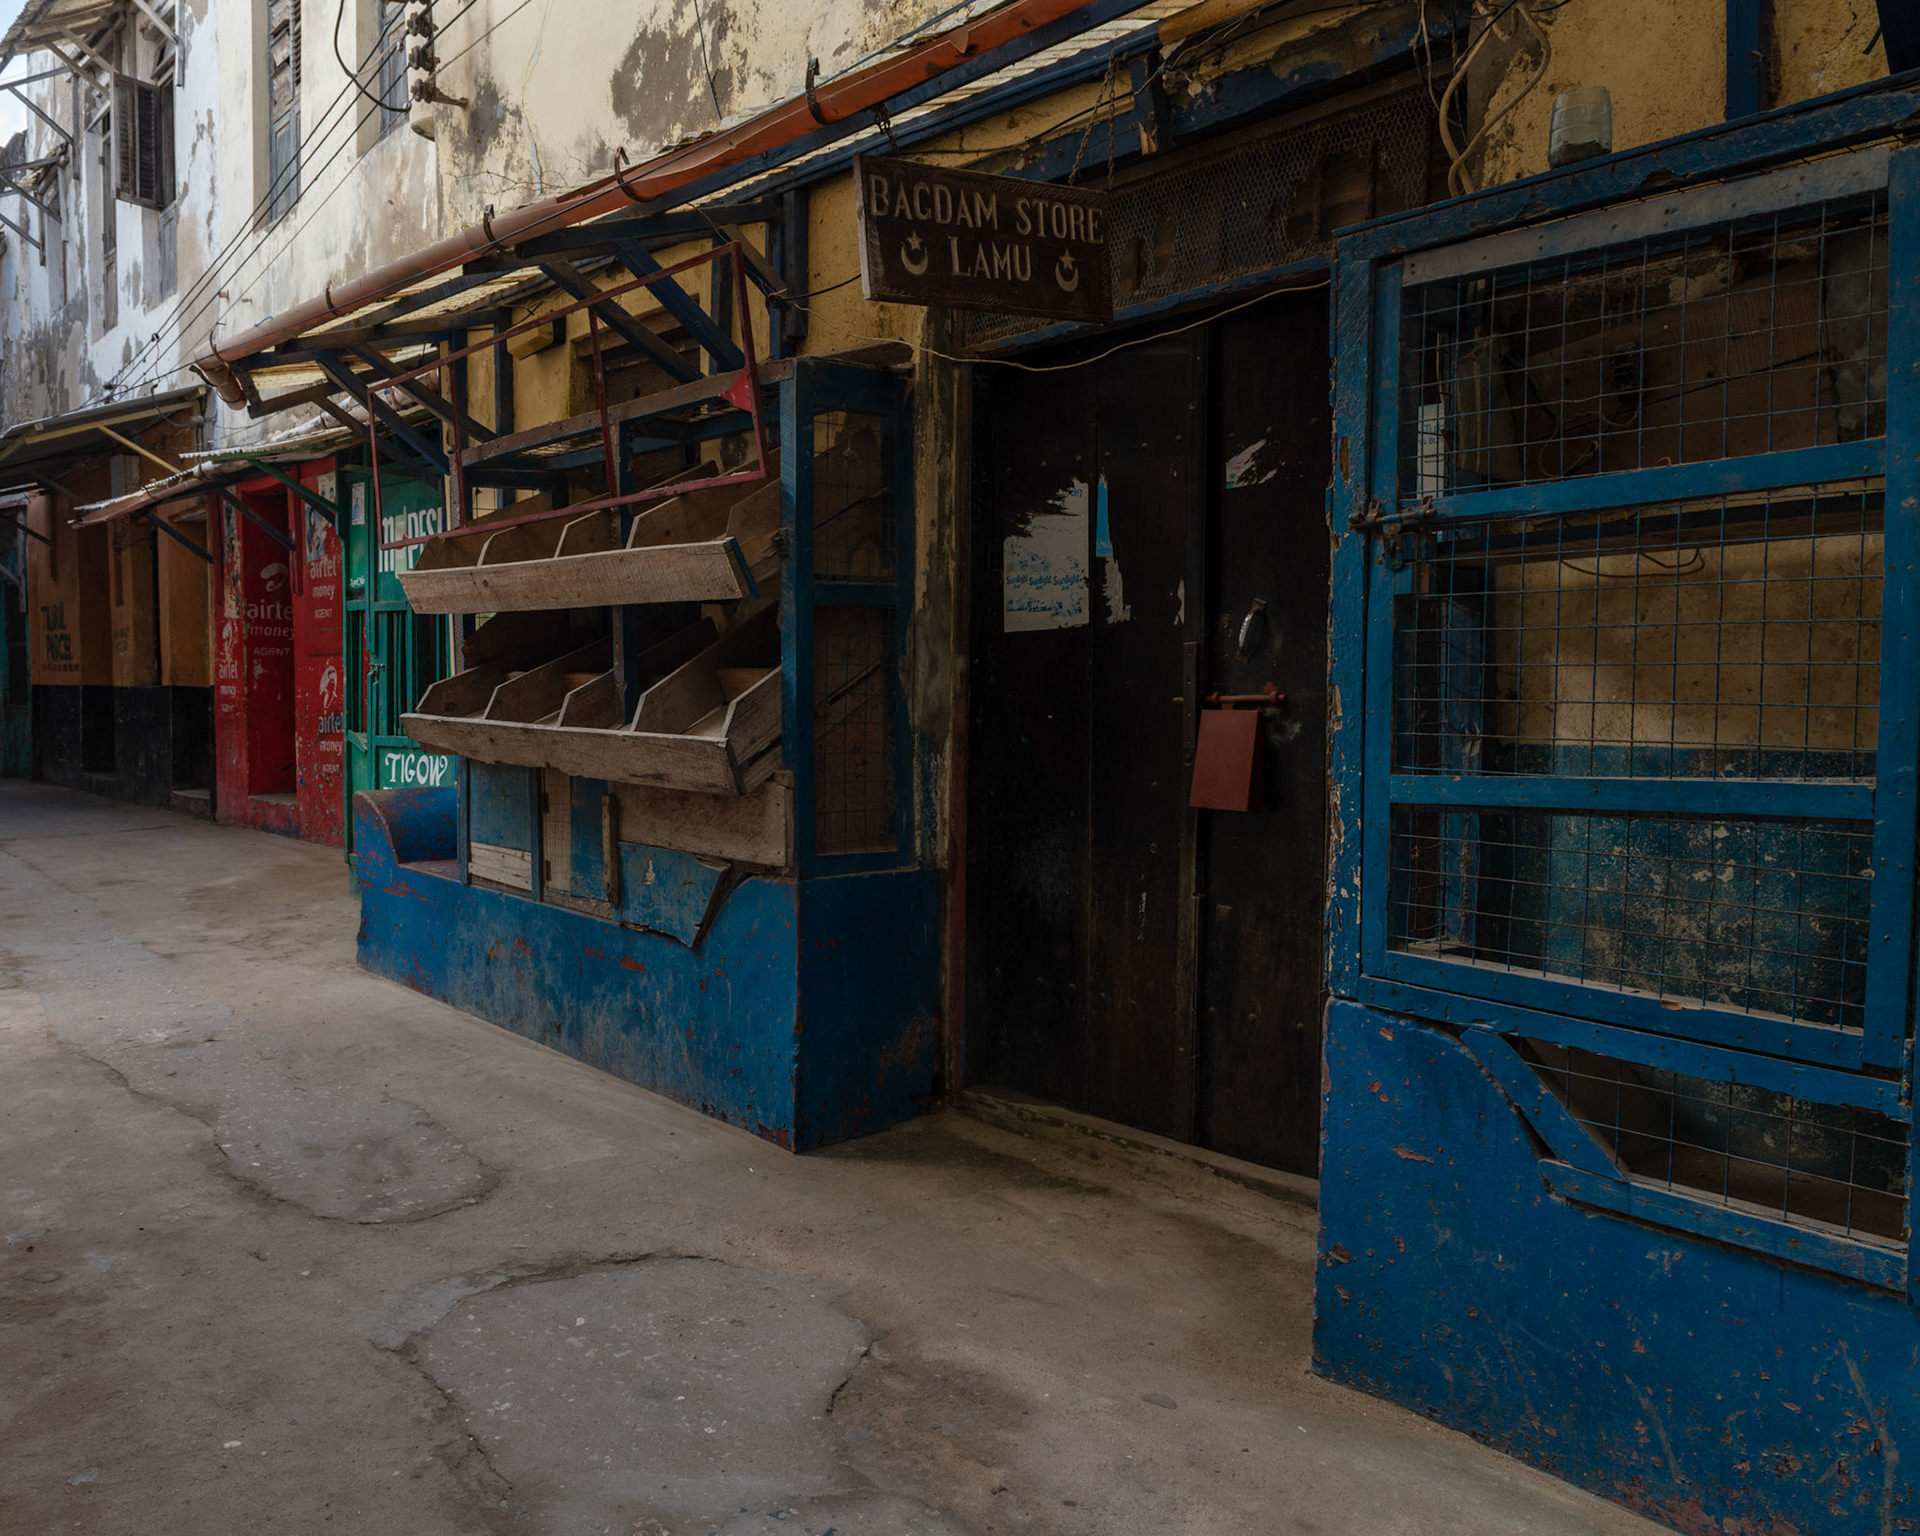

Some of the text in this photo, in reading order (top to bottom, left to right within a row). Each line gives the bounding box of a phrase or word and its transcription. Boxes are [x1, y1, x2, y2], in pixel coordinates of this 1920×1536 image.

[869, 174, 1104, 245] BAGDAM STORE
[948, 235, 1032, 282] LAMU
[310, 555, 337, 579] airtel
[312, 584, 335, 601] money
[247, 598, 293, 621] airte
[314, 608, 333, 619] AGENT
[253, 647, 290, 656] AGENT
[318, 709, 345, 733] airtel
[320, 740, 343, 756] money
